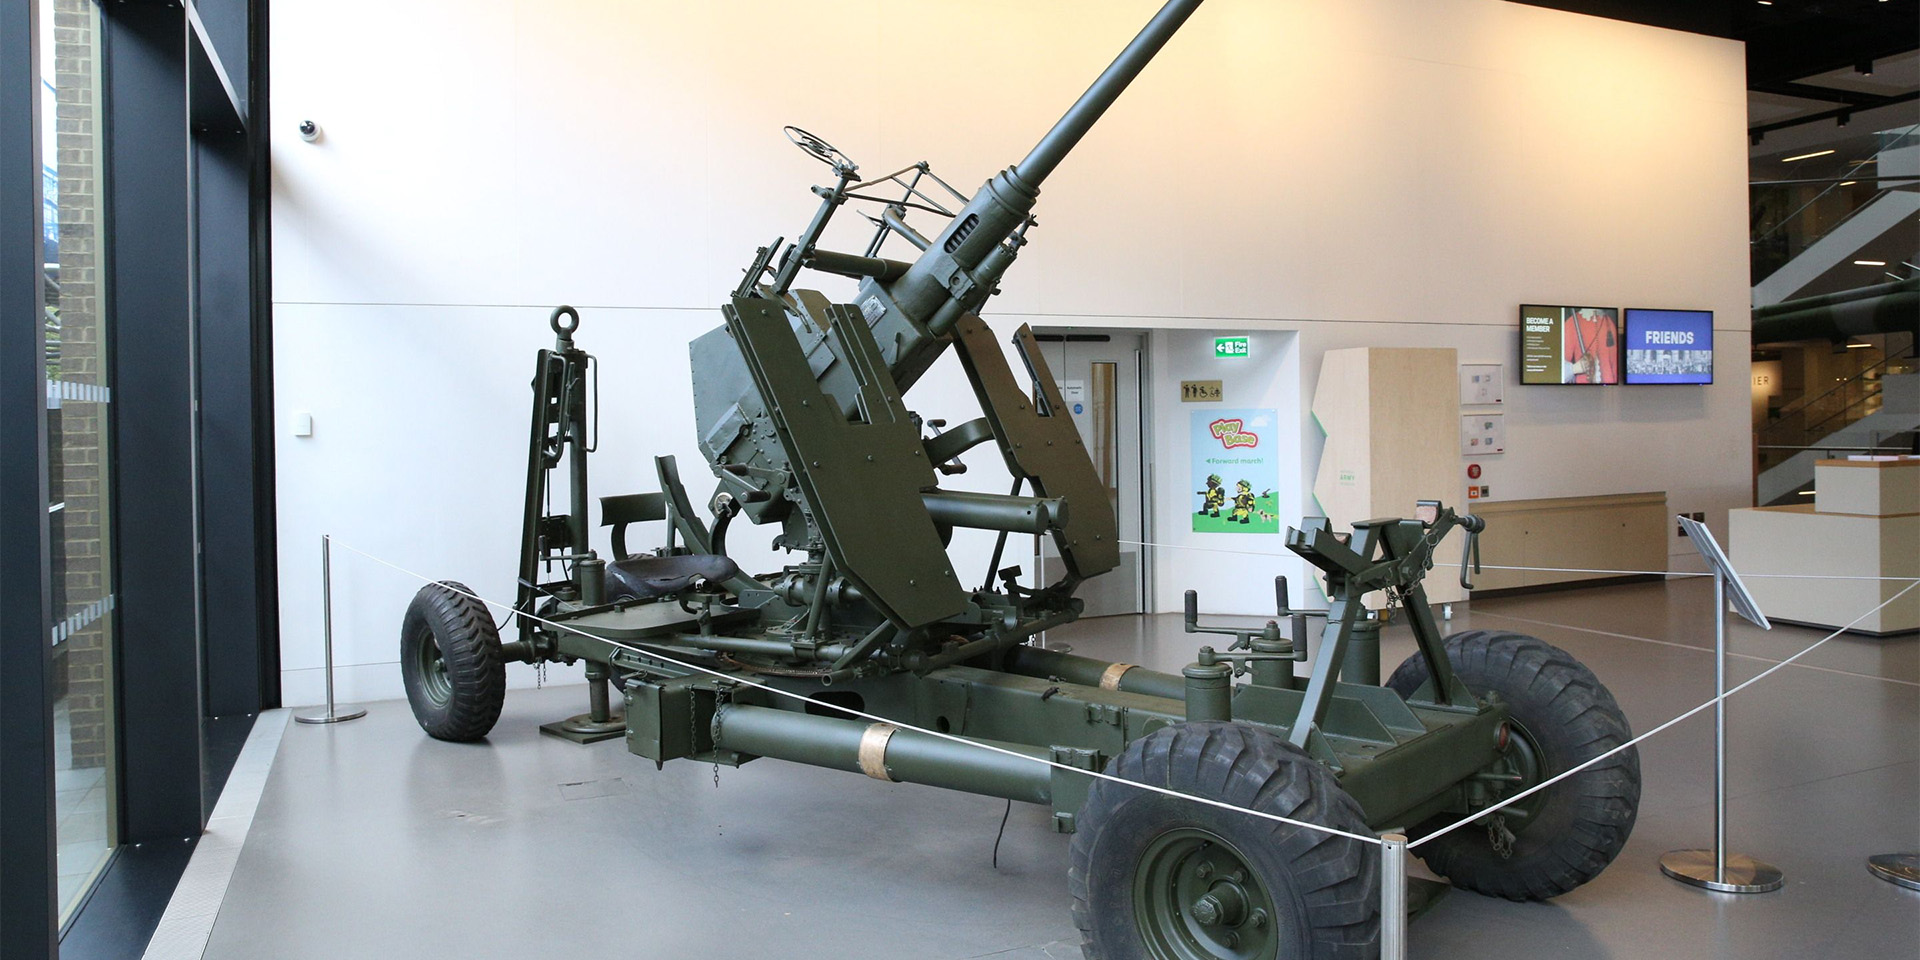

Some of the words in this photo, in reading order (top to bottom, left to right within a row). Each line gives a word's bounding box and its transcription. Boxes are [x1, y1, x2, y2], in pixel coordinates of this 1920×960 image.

[1646, 330, 1694, 344] FRIENDS
[1213, 422, 1240, 436] Play
[1225, 433, 1255, 446] Base
